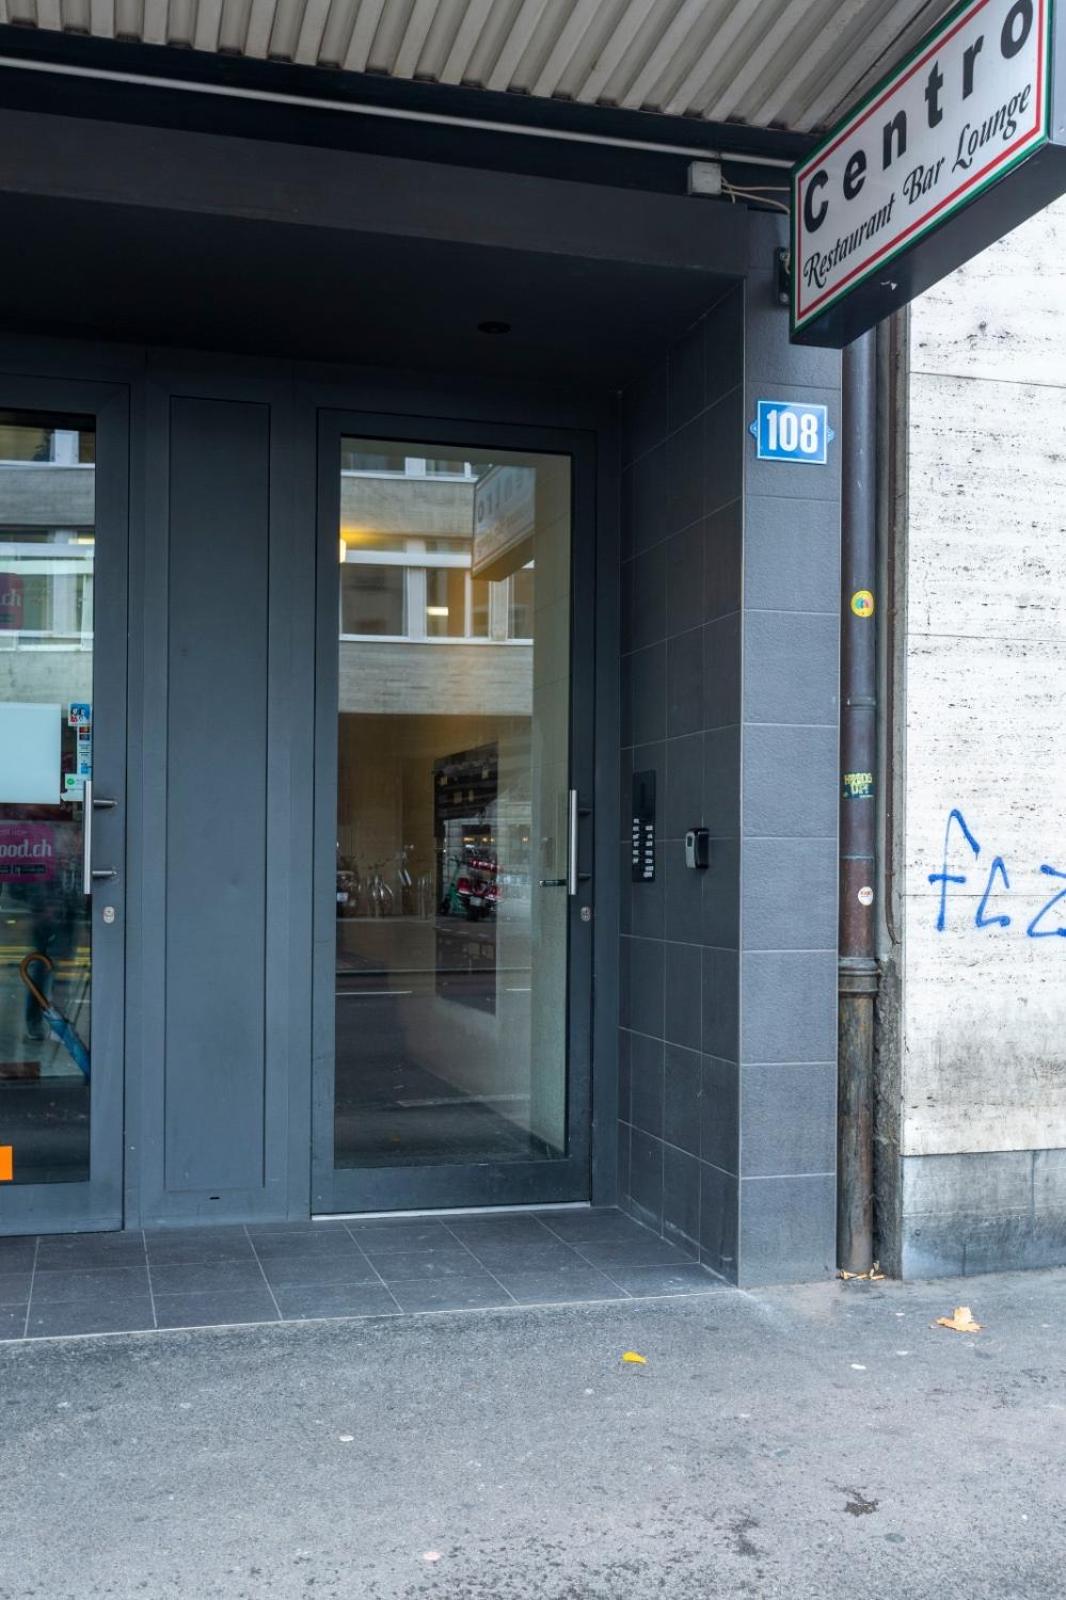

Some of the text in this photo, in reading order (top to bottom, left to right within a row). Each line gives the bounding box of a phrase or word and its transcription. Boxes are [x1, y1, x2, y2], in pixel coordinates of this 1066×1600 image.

[804, 0, 1033, 233] Centro
[804, 83, 1031, 289] Restaurant Bar Lounge
[767, 409, 818, 454] 108
